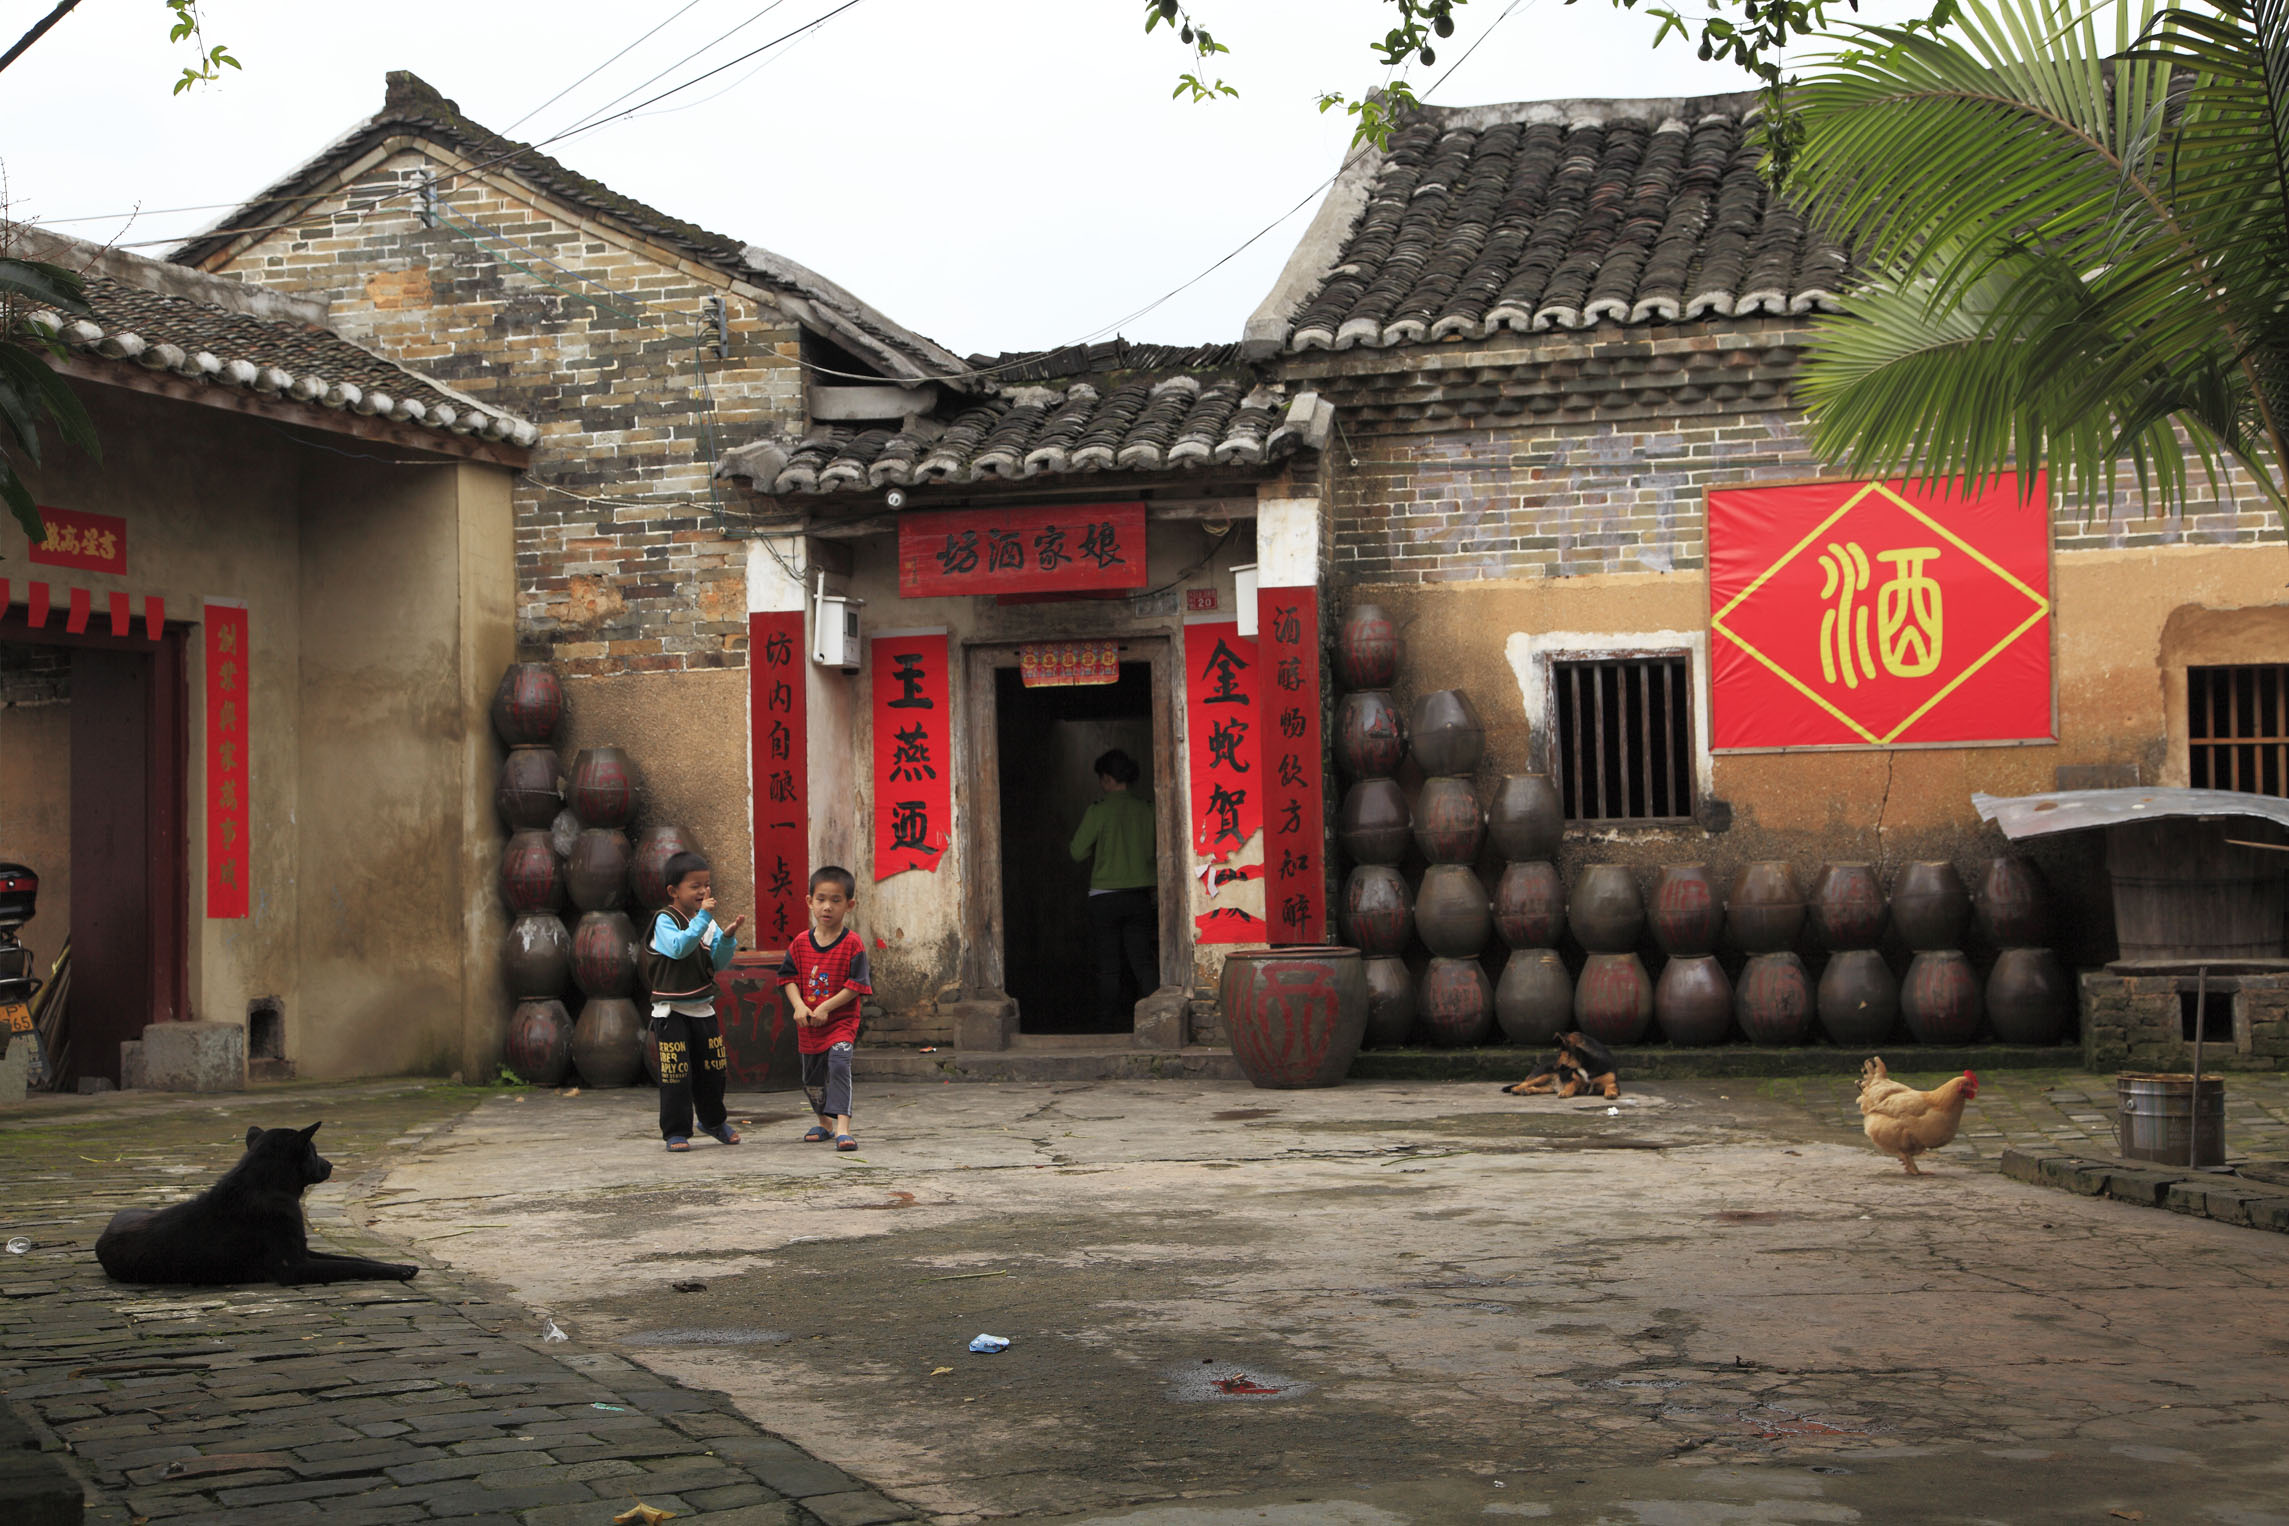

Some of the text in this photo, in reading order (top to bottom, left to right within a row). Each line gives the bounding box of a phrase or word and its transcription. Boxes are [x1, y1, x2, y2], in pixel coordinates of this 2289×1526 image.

[936, 521, 1126, 575] 娘家酒坊
[1198, 598, 1212, 608] 20
[1818, 541, 1943, 689] 酒
[887, 653, 939, 870] 玉燕迎
